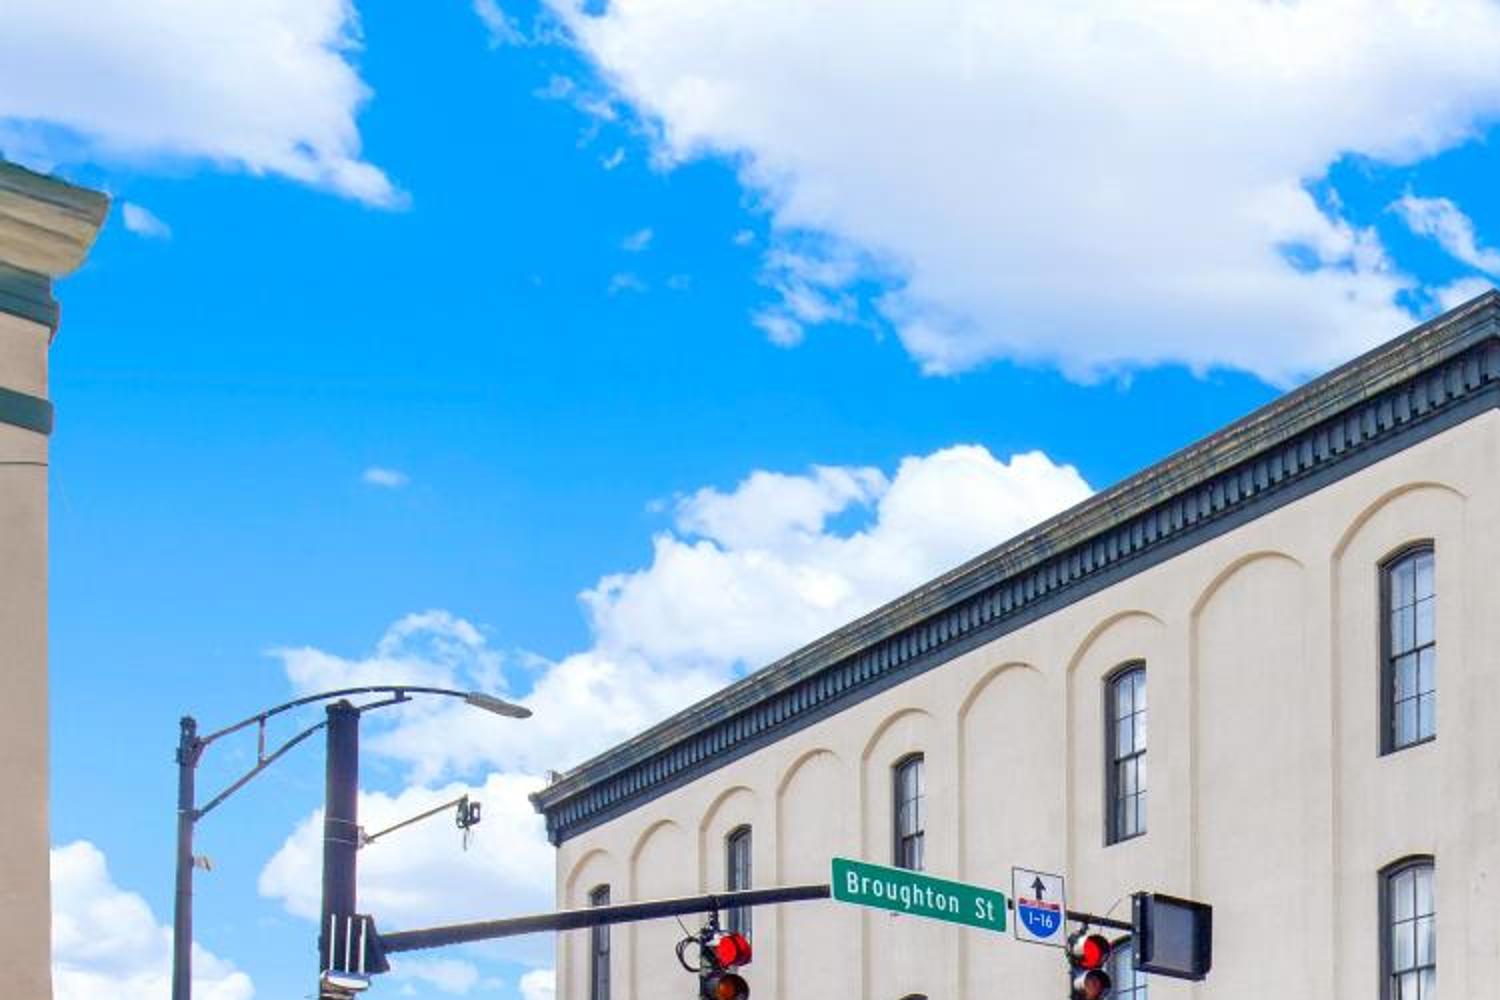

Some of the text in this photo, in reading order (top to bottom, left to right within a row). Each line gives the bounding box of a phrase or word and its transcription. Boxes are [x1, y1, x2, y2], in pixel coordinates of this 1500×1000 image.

[846, 870, 995, 921] Broughton St
[1028, 911, 1053, 928] I-16
